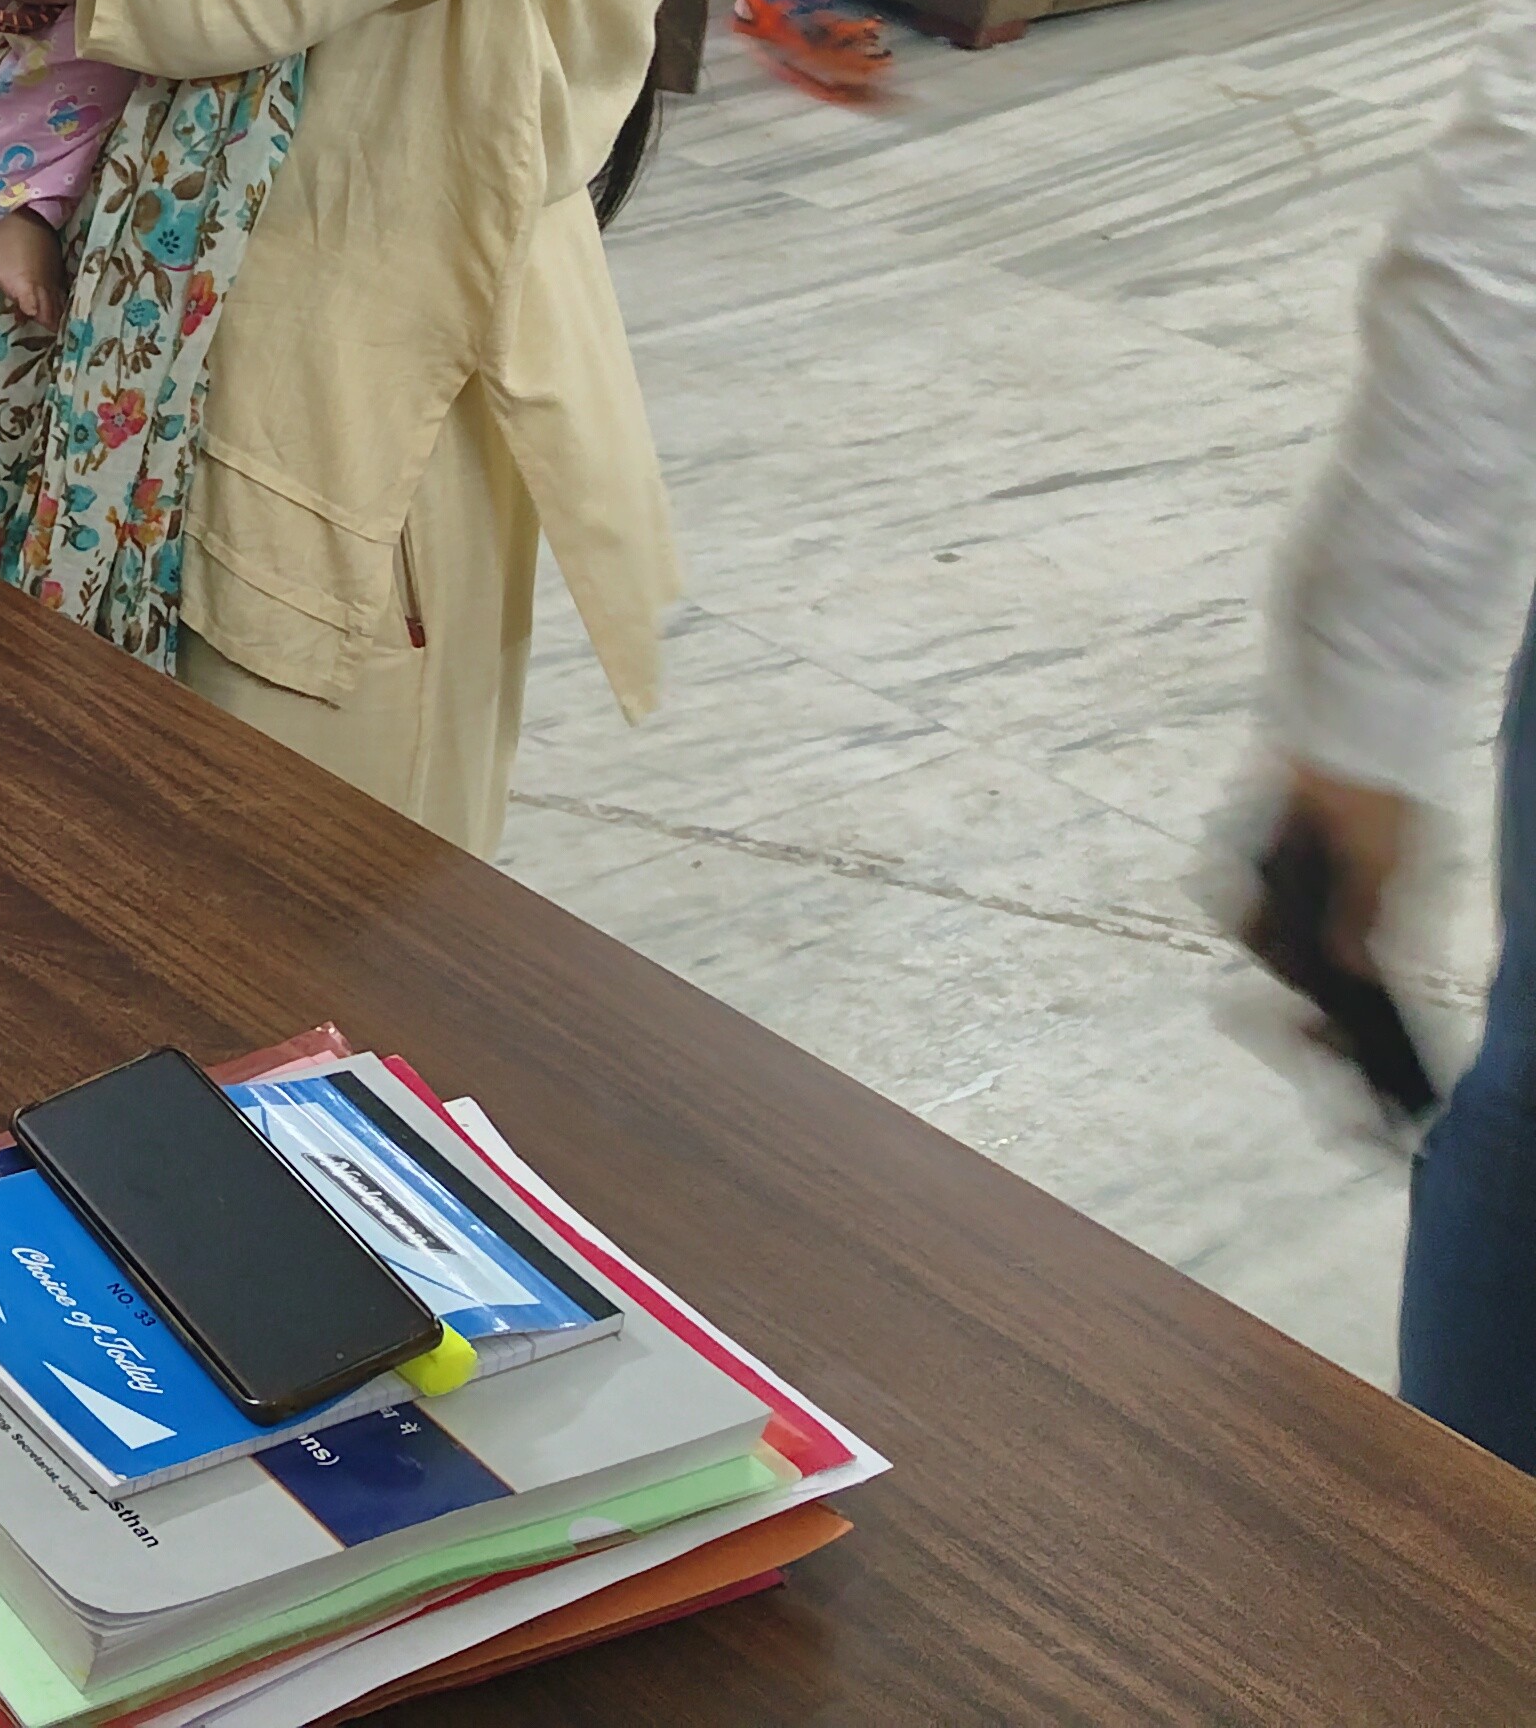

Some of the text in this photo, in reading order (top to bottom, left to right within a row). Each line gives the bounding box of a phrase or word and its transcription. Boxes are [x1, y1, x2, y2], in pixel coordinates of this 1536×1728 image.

[11, 1246, 164, 1394] Choice of Today
[134, 1309, 157, 1327] 33
[57, 1482, 90, 1513] Jaipur
[107, 1497, 160, 1550] sthan
